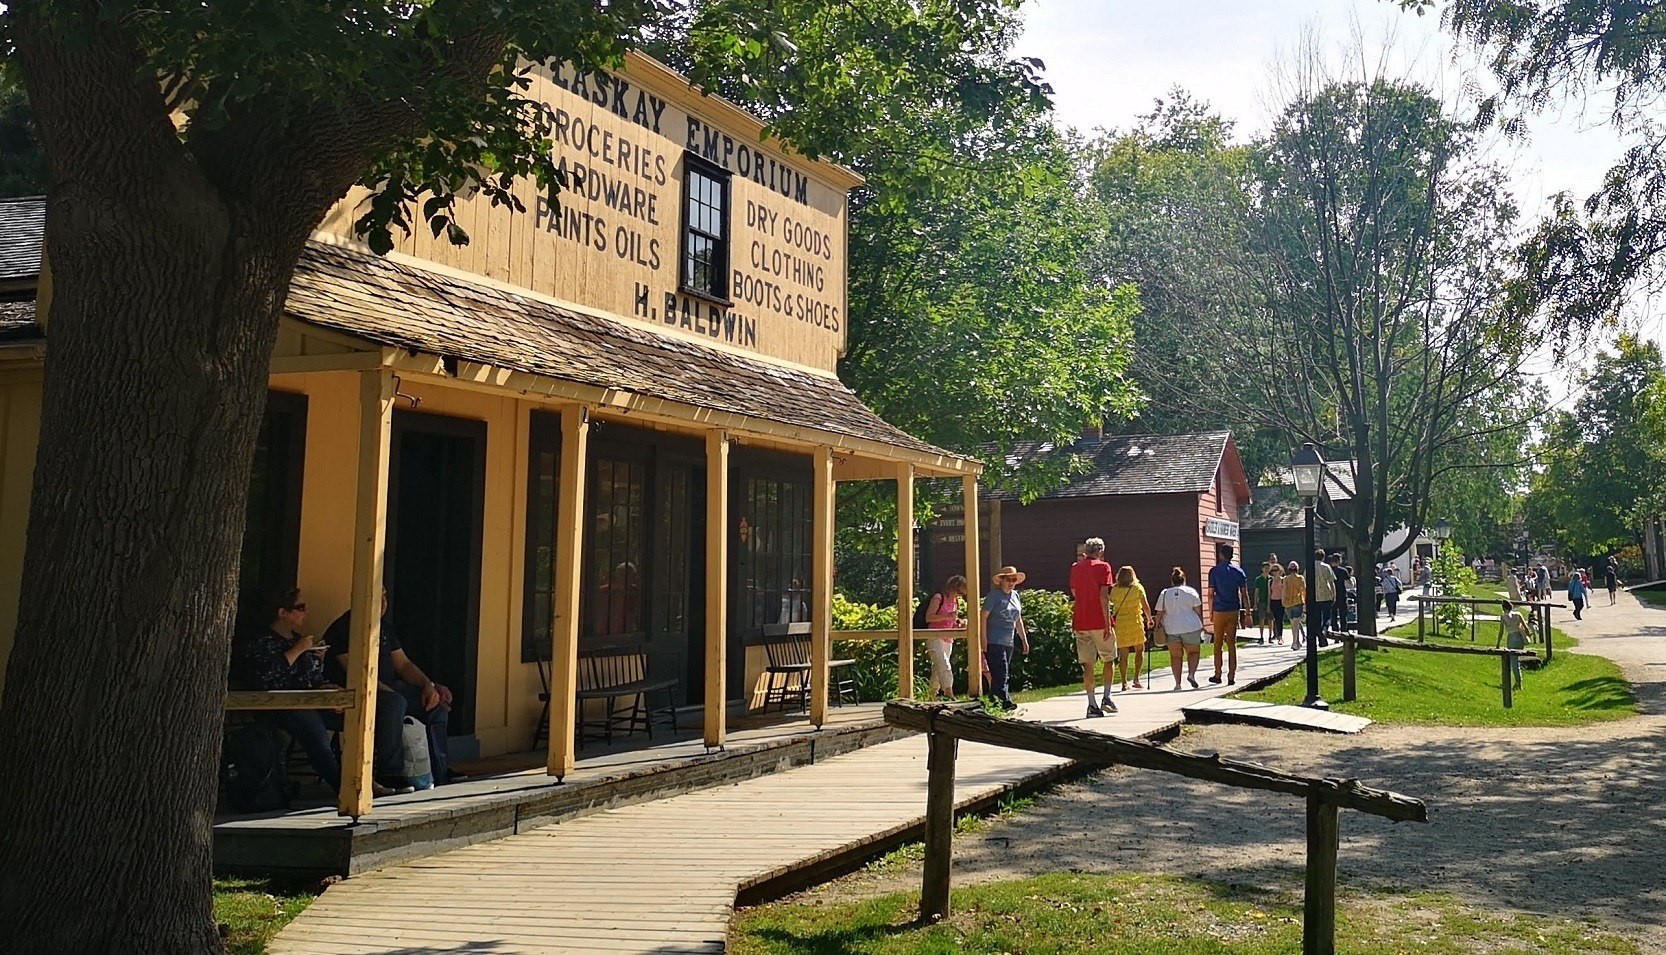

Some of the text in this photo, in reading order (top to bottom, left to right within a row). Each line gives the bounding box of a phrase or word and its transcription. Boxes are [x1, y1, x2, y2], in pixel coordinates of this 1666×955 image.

[547, 152, 659, 226] ARDWARE
[686, 115, 808, 206] EMPORIUM
[535, 195, 660, 270] PAINTS OILS
[747, 199, 831, 261] DRY GOODS
[751, 240, 824, 293] CLOTHING
[634, 281, 756, 349] H. BALDWIN
